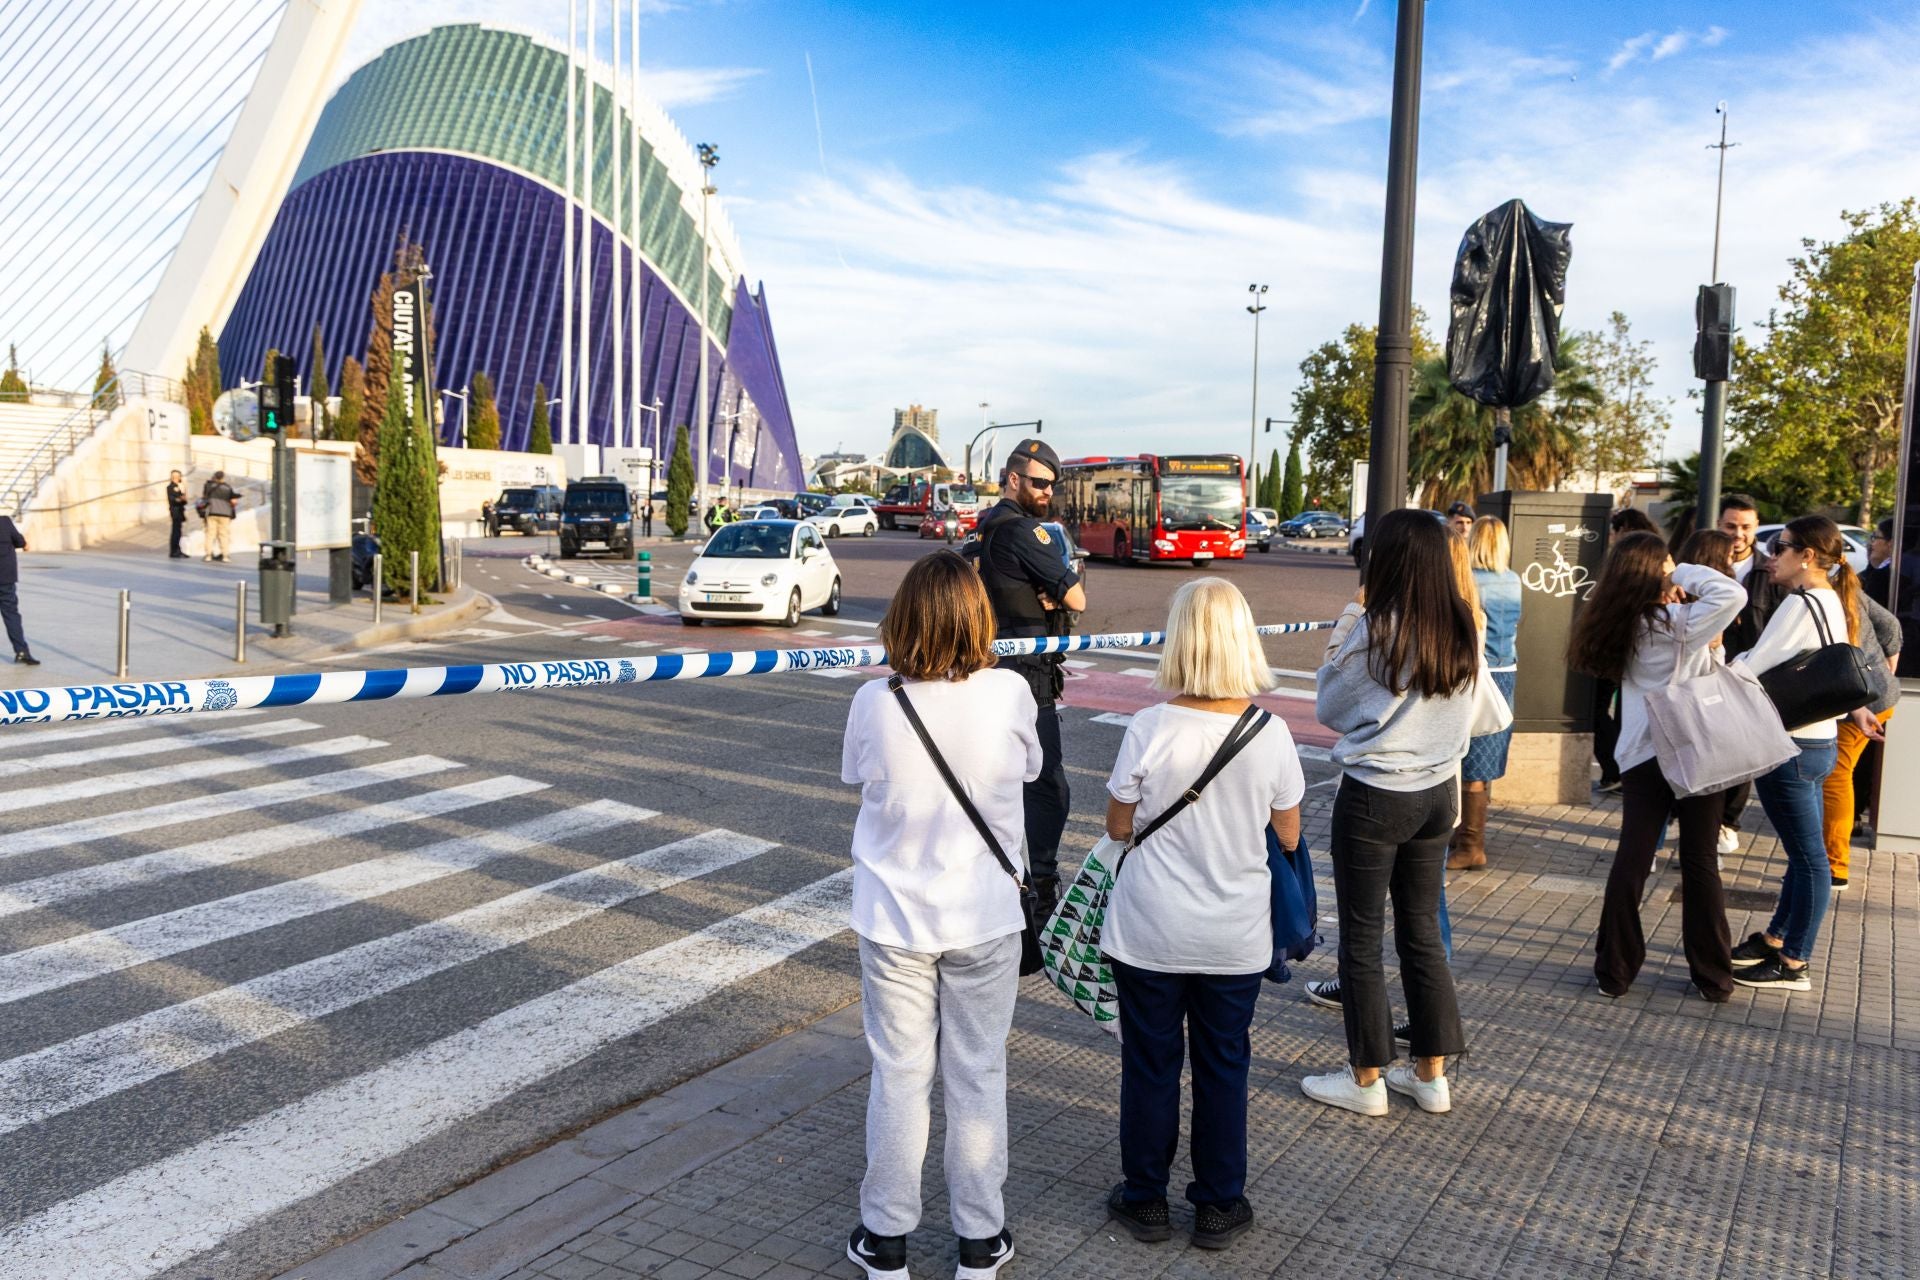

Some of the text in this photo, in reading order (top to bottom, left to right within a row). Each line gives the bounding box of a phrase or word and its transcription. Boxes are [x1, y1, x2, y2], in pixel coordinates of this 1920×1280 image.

[393, 290, 414, 355] CIUTAT
[786, 649, 855, 668] NO PASAR
[992, 641, 1015, 655] ASAR
[499, 660, 611, 685] NO PASAR
[0, 682, 190, 714] NO PASAR
